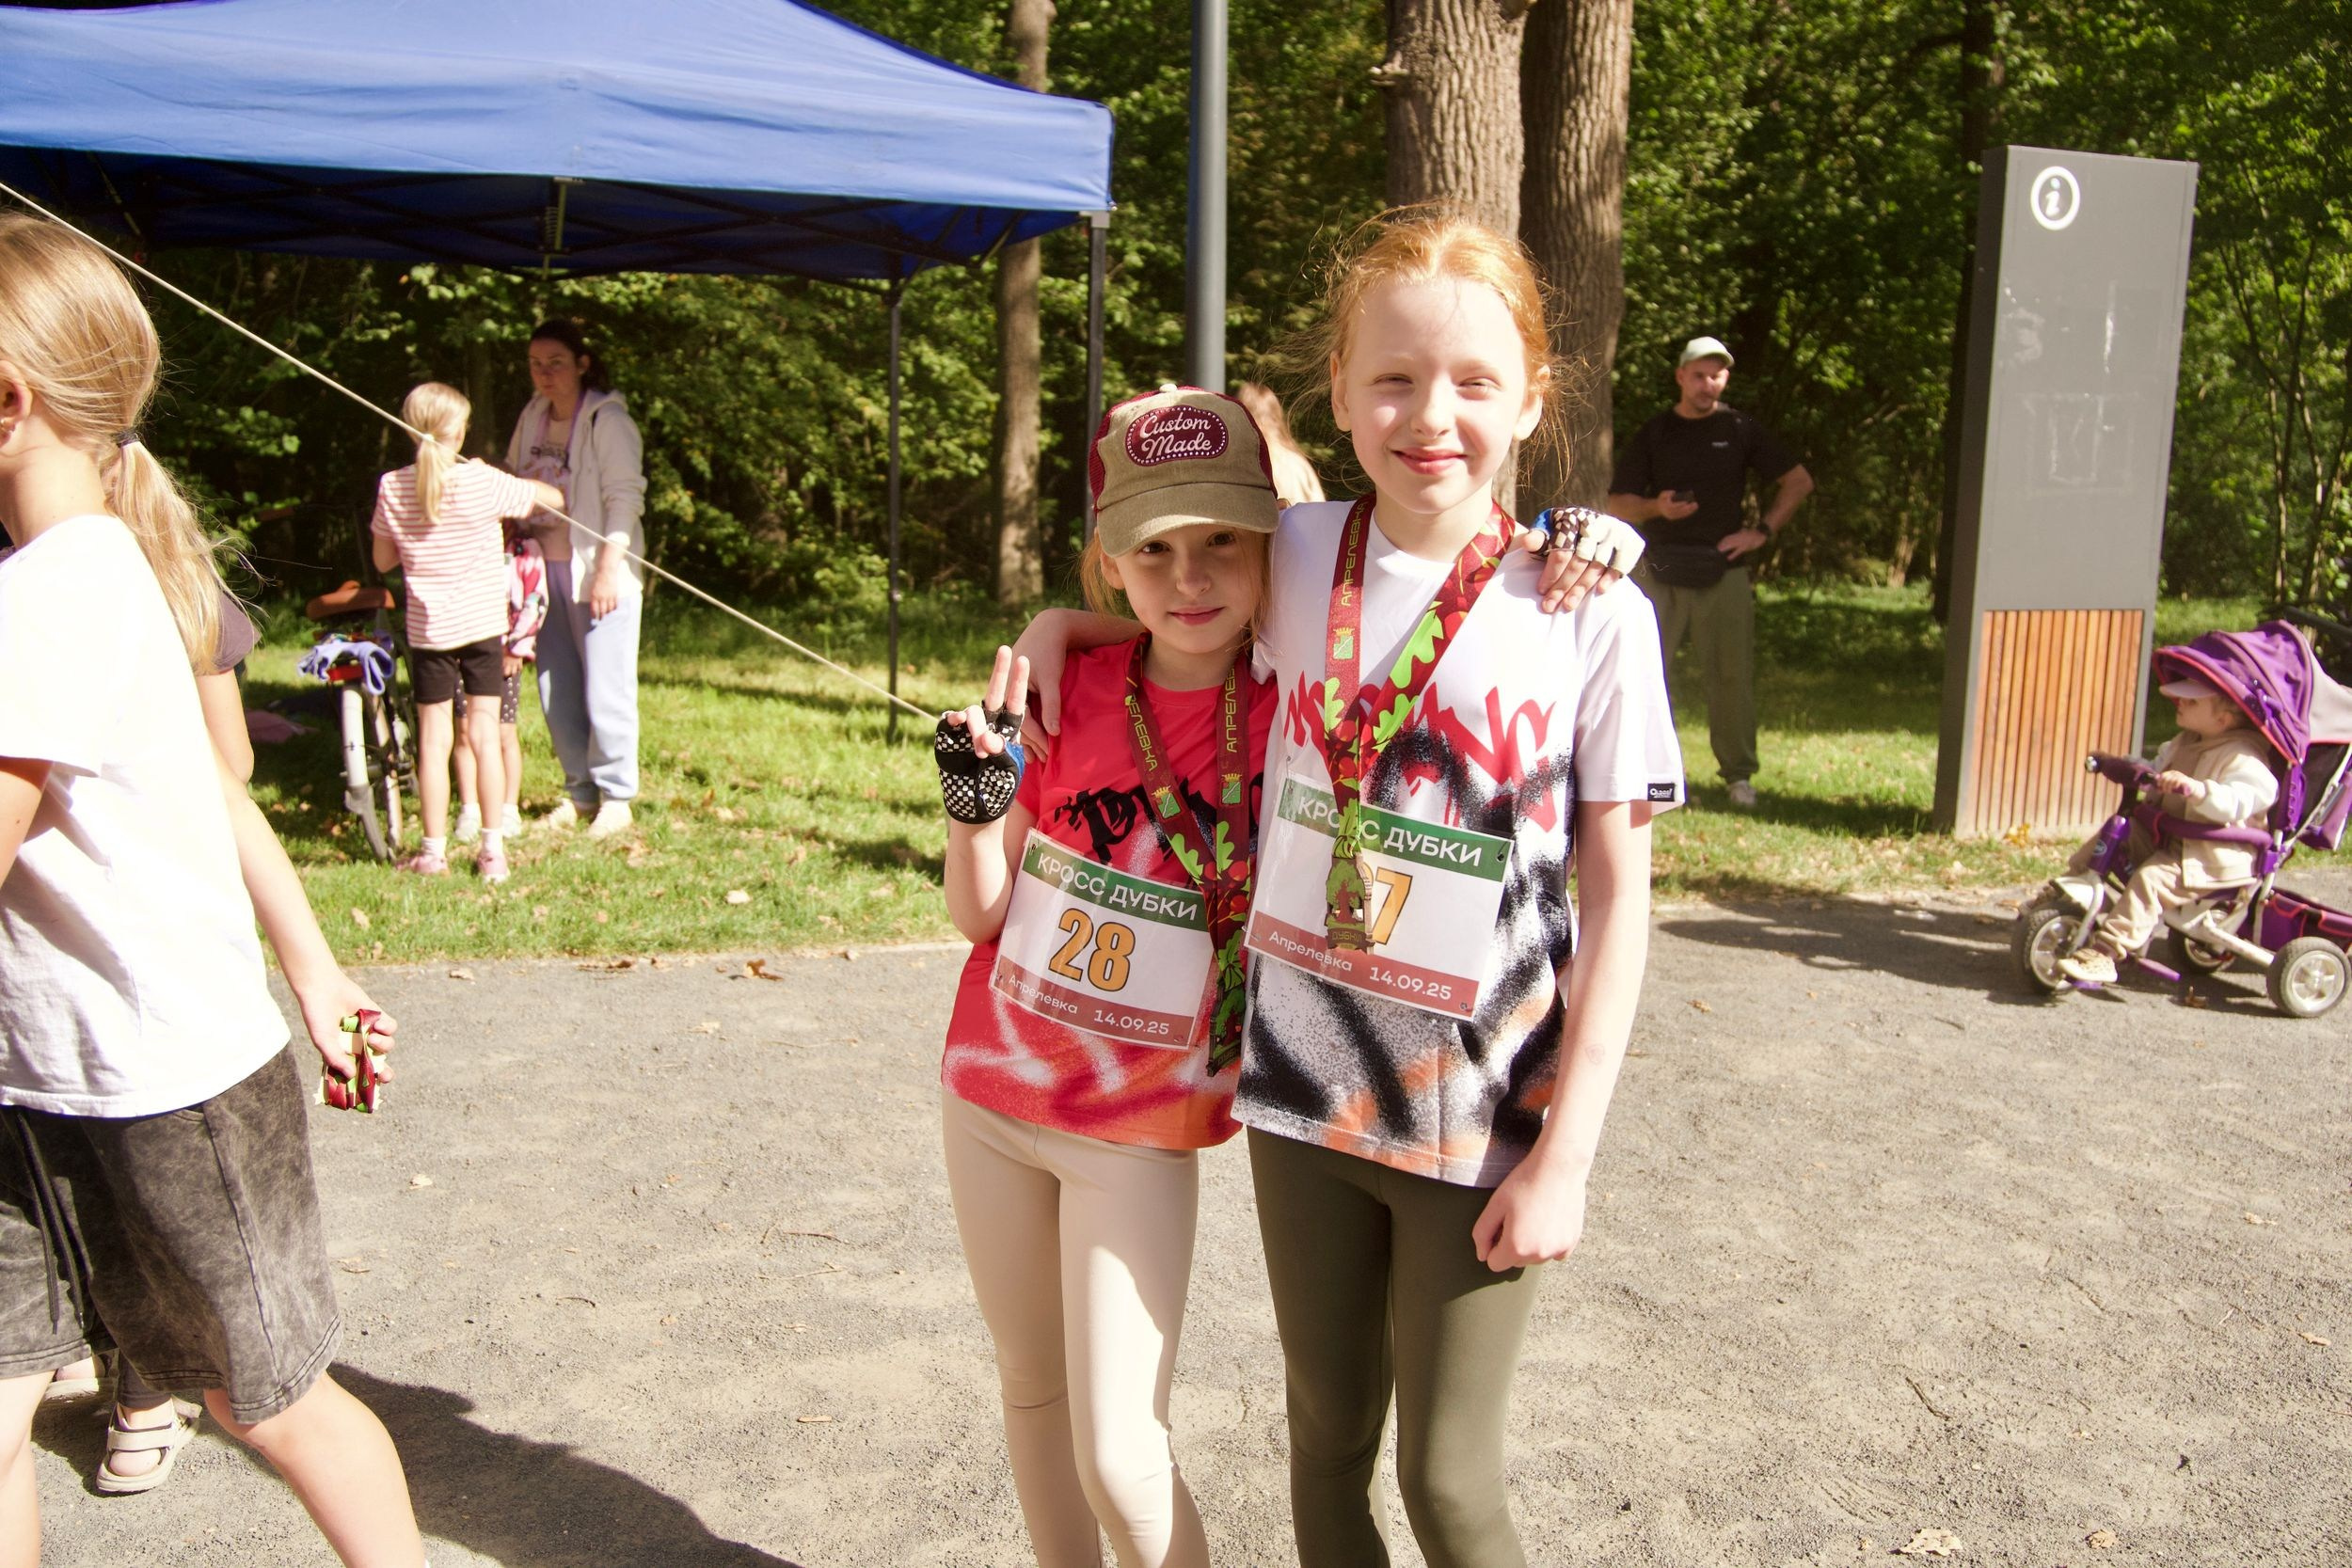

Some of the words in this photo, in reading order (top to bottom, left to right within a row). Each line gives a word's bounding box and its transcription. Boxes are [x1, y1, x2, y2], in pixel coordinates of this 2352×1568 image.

[1139, 412, 1211, 439] Custom
[1141, 433, 1212, 459] Made
[1298, 796, 1380, 841] КРОС
[1383, 827, 1482, 867] ДУБКИ
[1038, 852, 1106, 895] КРОСС
[1108, 884, 1198, 921] ДУБКИ
[1363, 861, 1413, 945] 7
[1048, 908, 1136, 992] 28
[1269, 930, 1354, 972] Апрелевка
[1370, 966, 1452, 1000] 14.09.25
[1009, 974, 1078, 1014] Апрелевка
[1094, 1009, 1170, 1036] 14.09.25
